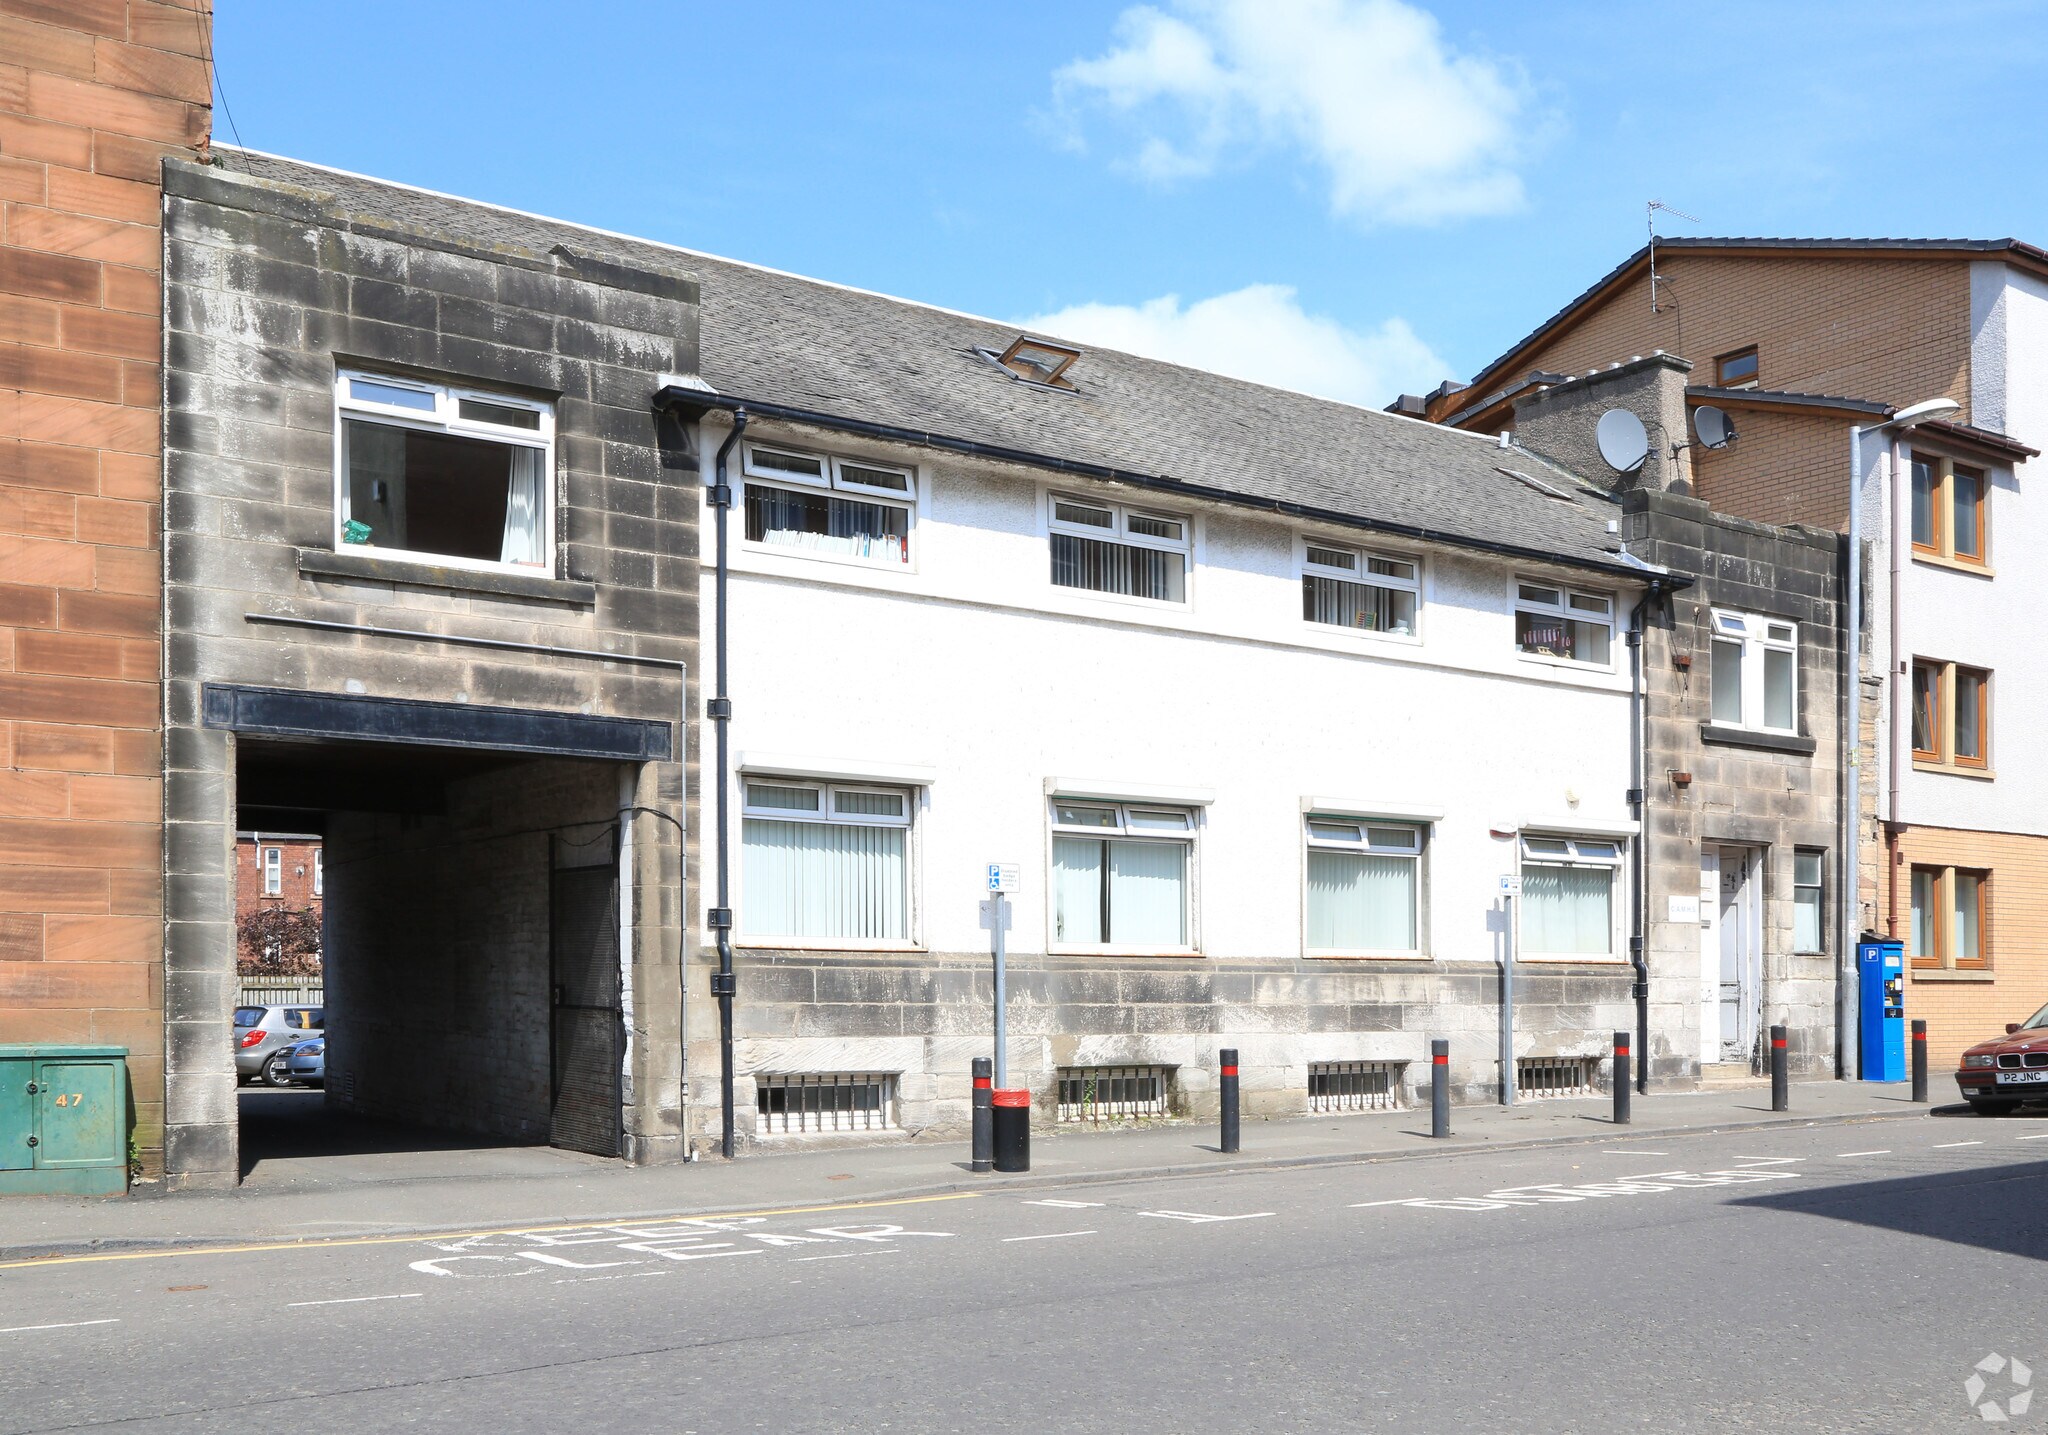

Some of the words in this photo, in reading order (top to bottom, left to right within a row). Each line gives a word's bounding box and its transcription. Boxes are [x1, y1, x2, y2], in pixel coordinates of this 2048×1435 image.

[2004, 1073, 2018, 1082] P2
[2020, 1072, 2041, 1081] JNC
[56, 1093, 83, 1107] 47
[1402, 1170, 1801, 1211] DISABLED
[408, 1224, 957, 1278] CLEAR
[420, 1217, 768, 1253] KEEP
